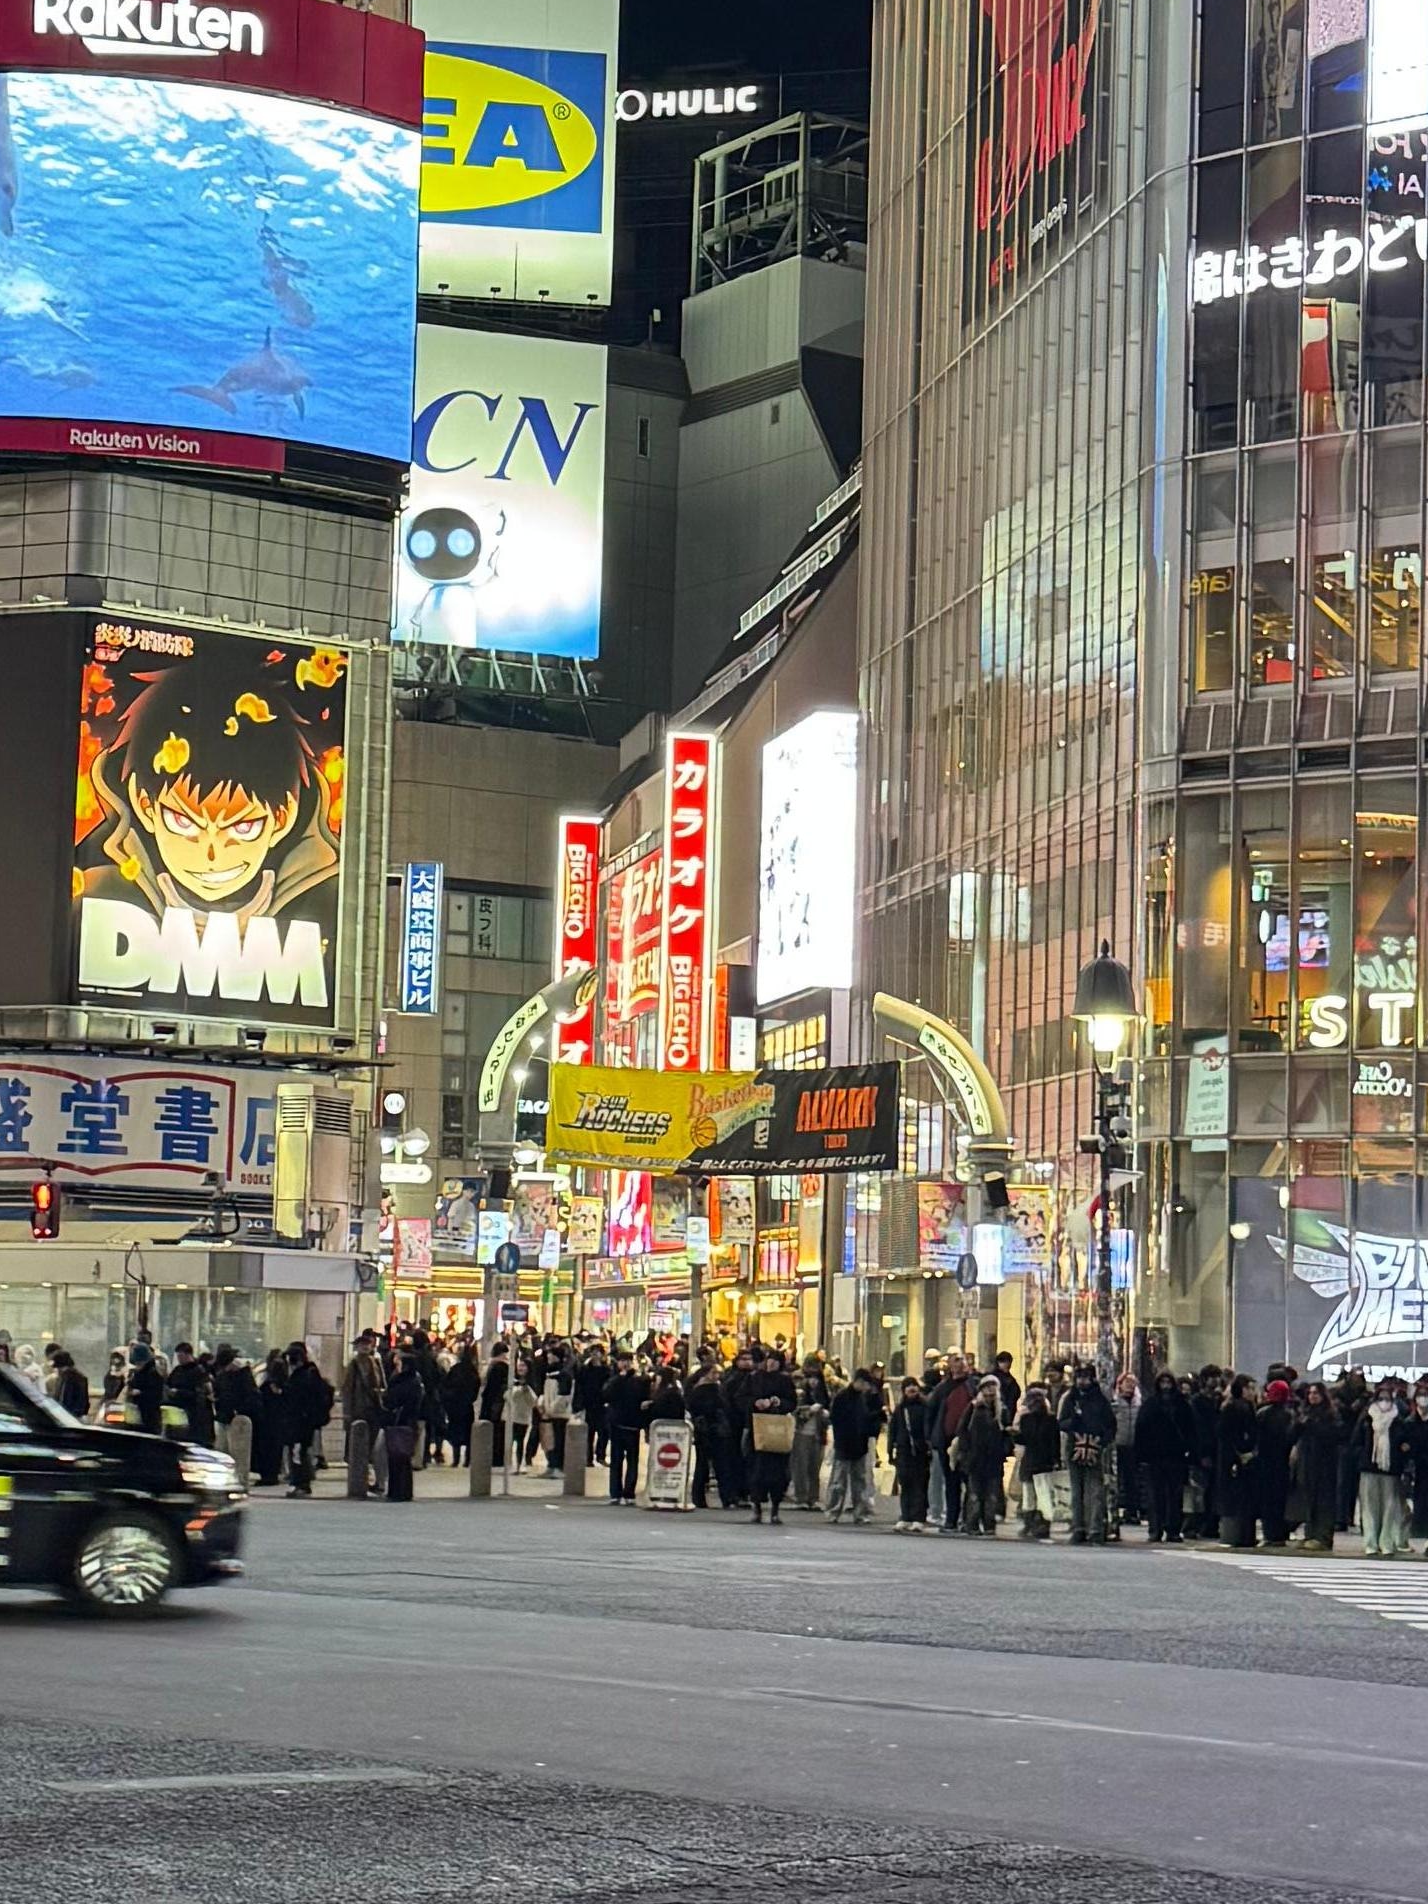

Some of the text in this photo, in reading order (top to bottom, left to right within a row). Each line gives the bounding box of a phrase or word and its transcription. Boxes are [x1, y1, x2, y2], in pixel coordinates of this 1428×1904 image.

[652, 85, 759, 117] HULIC
[70, 429, 200, 454] Rakuten Vision
[670, 758, 708, 935] カラオケ
[79, 897, 329, 1007] DMM
[409, 870, 435, 1007] 大盛堂商事ビル
[577, 1093, 672, 1136] ROCKERS
[600, 1095, 629, 1110] SUN
[796, 1086, 878, 1133] ALVARK
